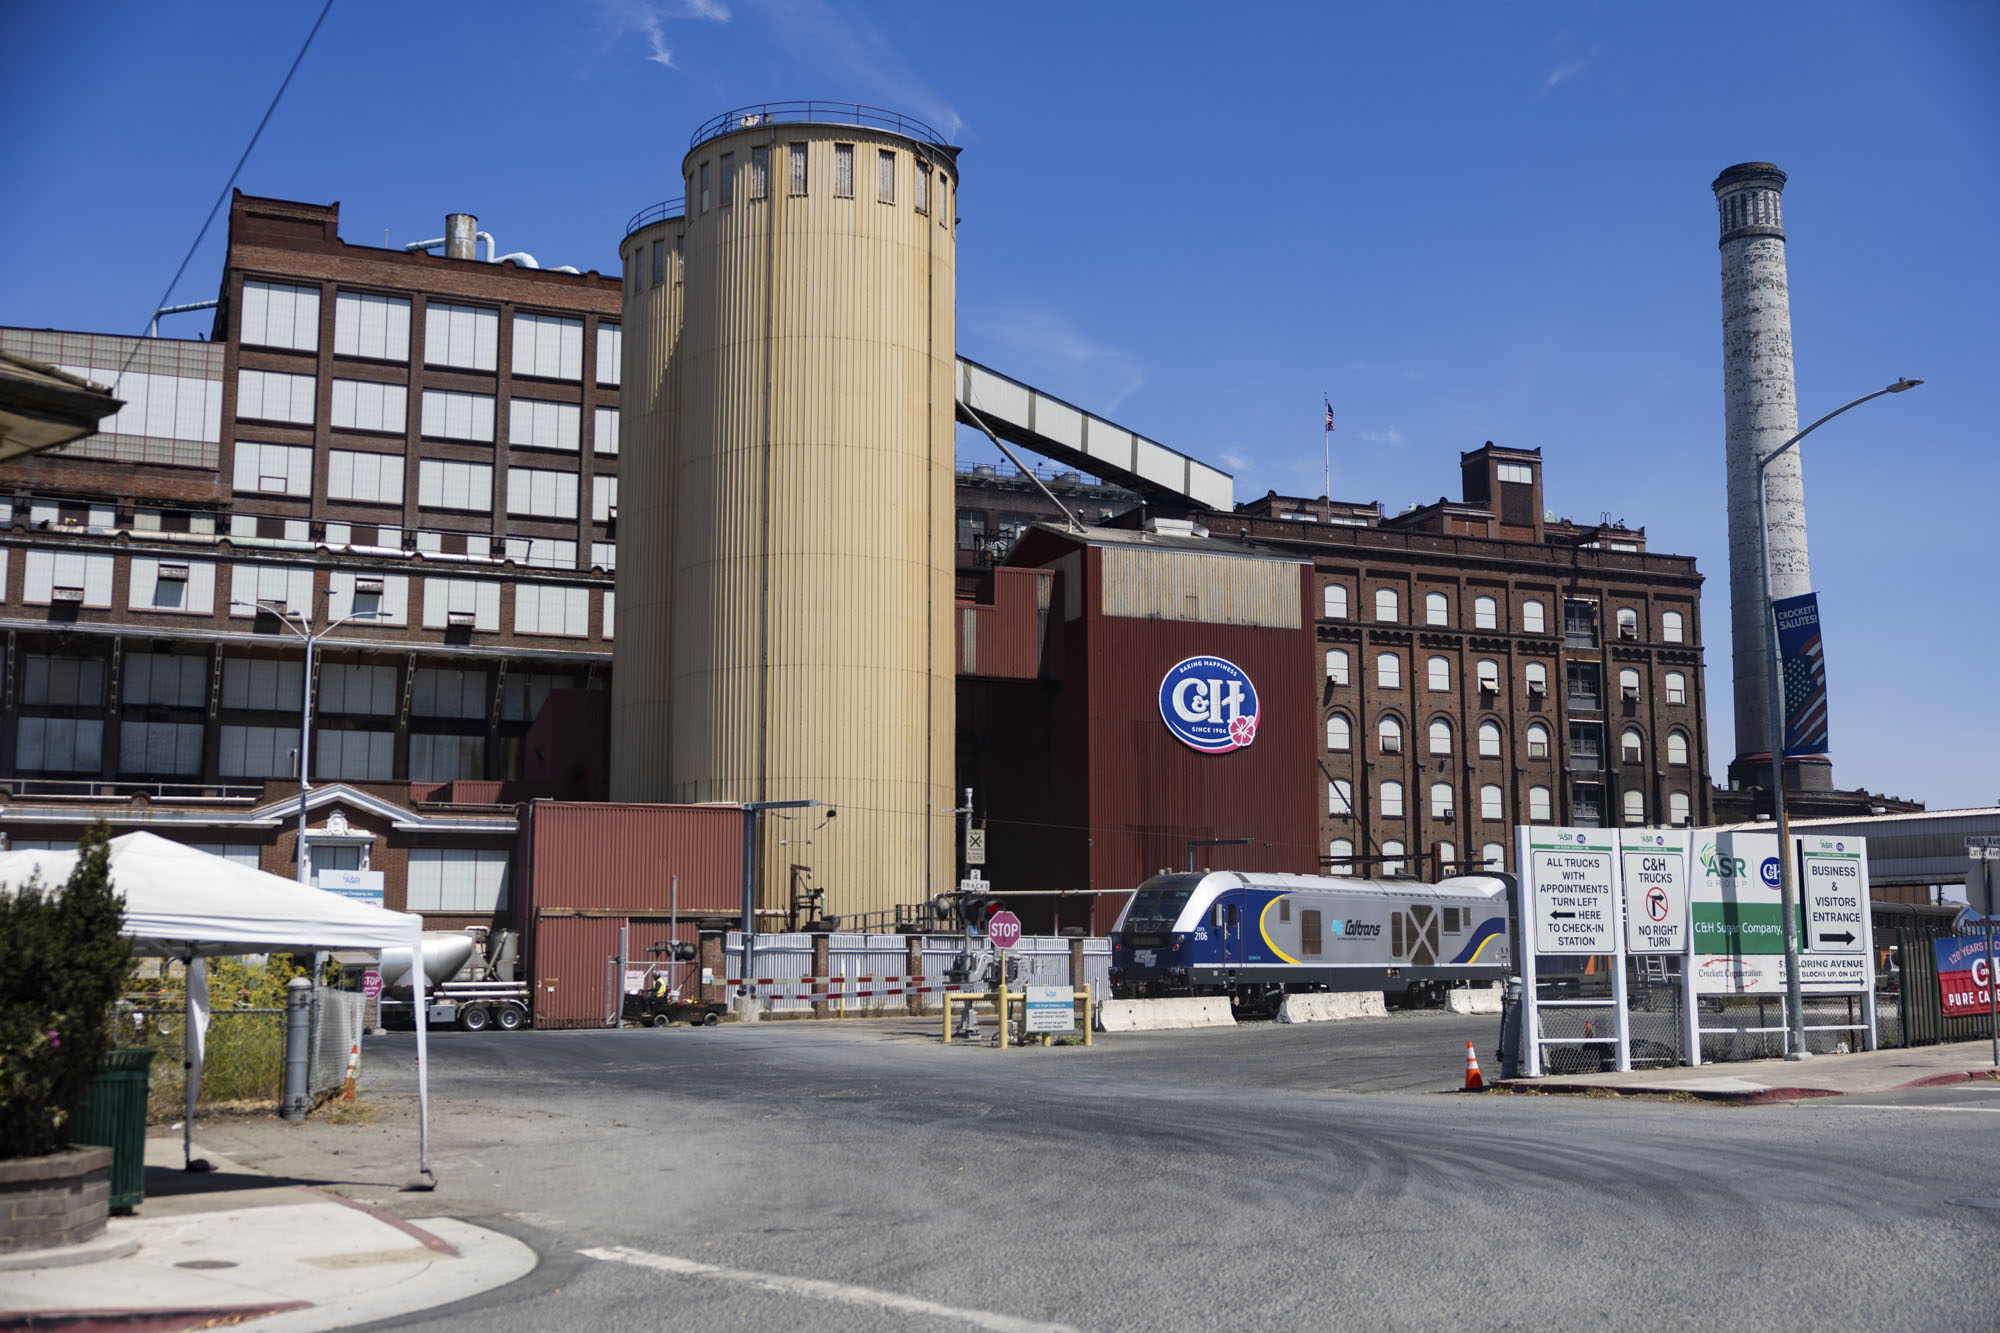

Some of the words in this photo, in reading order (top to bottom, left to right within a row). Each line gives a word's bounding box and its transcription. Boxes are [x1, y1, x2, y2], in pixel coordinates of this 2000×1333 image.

[1778, 605, 1815, 620] CROCKETT
[1780, 614, 1818, 630] SALUTES!
[1179, 661, 1203, 673] BAKING
[1204, 661, 1237, 677] HAPPINESS
[1172, 678, 1245, 723] C&H
[1546, 858, 1563, 867] ALL
[1565, 858, 1600, 868] TRUCKS
[1642, 858, 1666, 871] C&H
[1705, 855, 1747, 878] ASR
[1562, 872, 1585, 880] WITH
[1812, 866, 1856, 877] BUSINESS
[1638, 873, 1672, 883] TRUCKS
[1540, 884, 1609, 894] APPOINTMENTS
[1707, 880, 1747, 888] GROUP
[1831, 882, 1838, 891] &
[1551, 897, 1575, 906] TURN
[1577, 897, 1598, 906] LEFT
[1815, 897, 1856, 907] VISITORS
[1578, 911, 1601, 919] HERE
[1813, 912, 1861, 922] ENTRANCE
[991, 922, 1019, 938] STOP
[1345, 919, 1381, 936] Caltrans
[1548, 924, 1560, 932] TO
[1562, 924, 1604, 933] CHECK-IN
[1639, 925, 1651, 935] NO
[1653, 925, 1678, 935] RIGHT
[1695, 922, 1714, 933] C&H
[1717, 922, 1739, 935] Sugar
[1742, 922, 1783, 935] Company,
[1194, 931, 1208, 940] 2106
[1558, 937, 1595, 945] STATION
[1648, 937, 1670, 947] TURN
[1948, 951, 1960, 966] 120
[1960, 941, 1983, 957] YEARS
[1830, 960, 1864, 968] AVENUE
[1698, 969, 1724, 977] Crockett
[1980, 968, 1990, 976] an
[362, 976, 380, 985] STOP
[1948, 992, 1975, 1006] PURE
